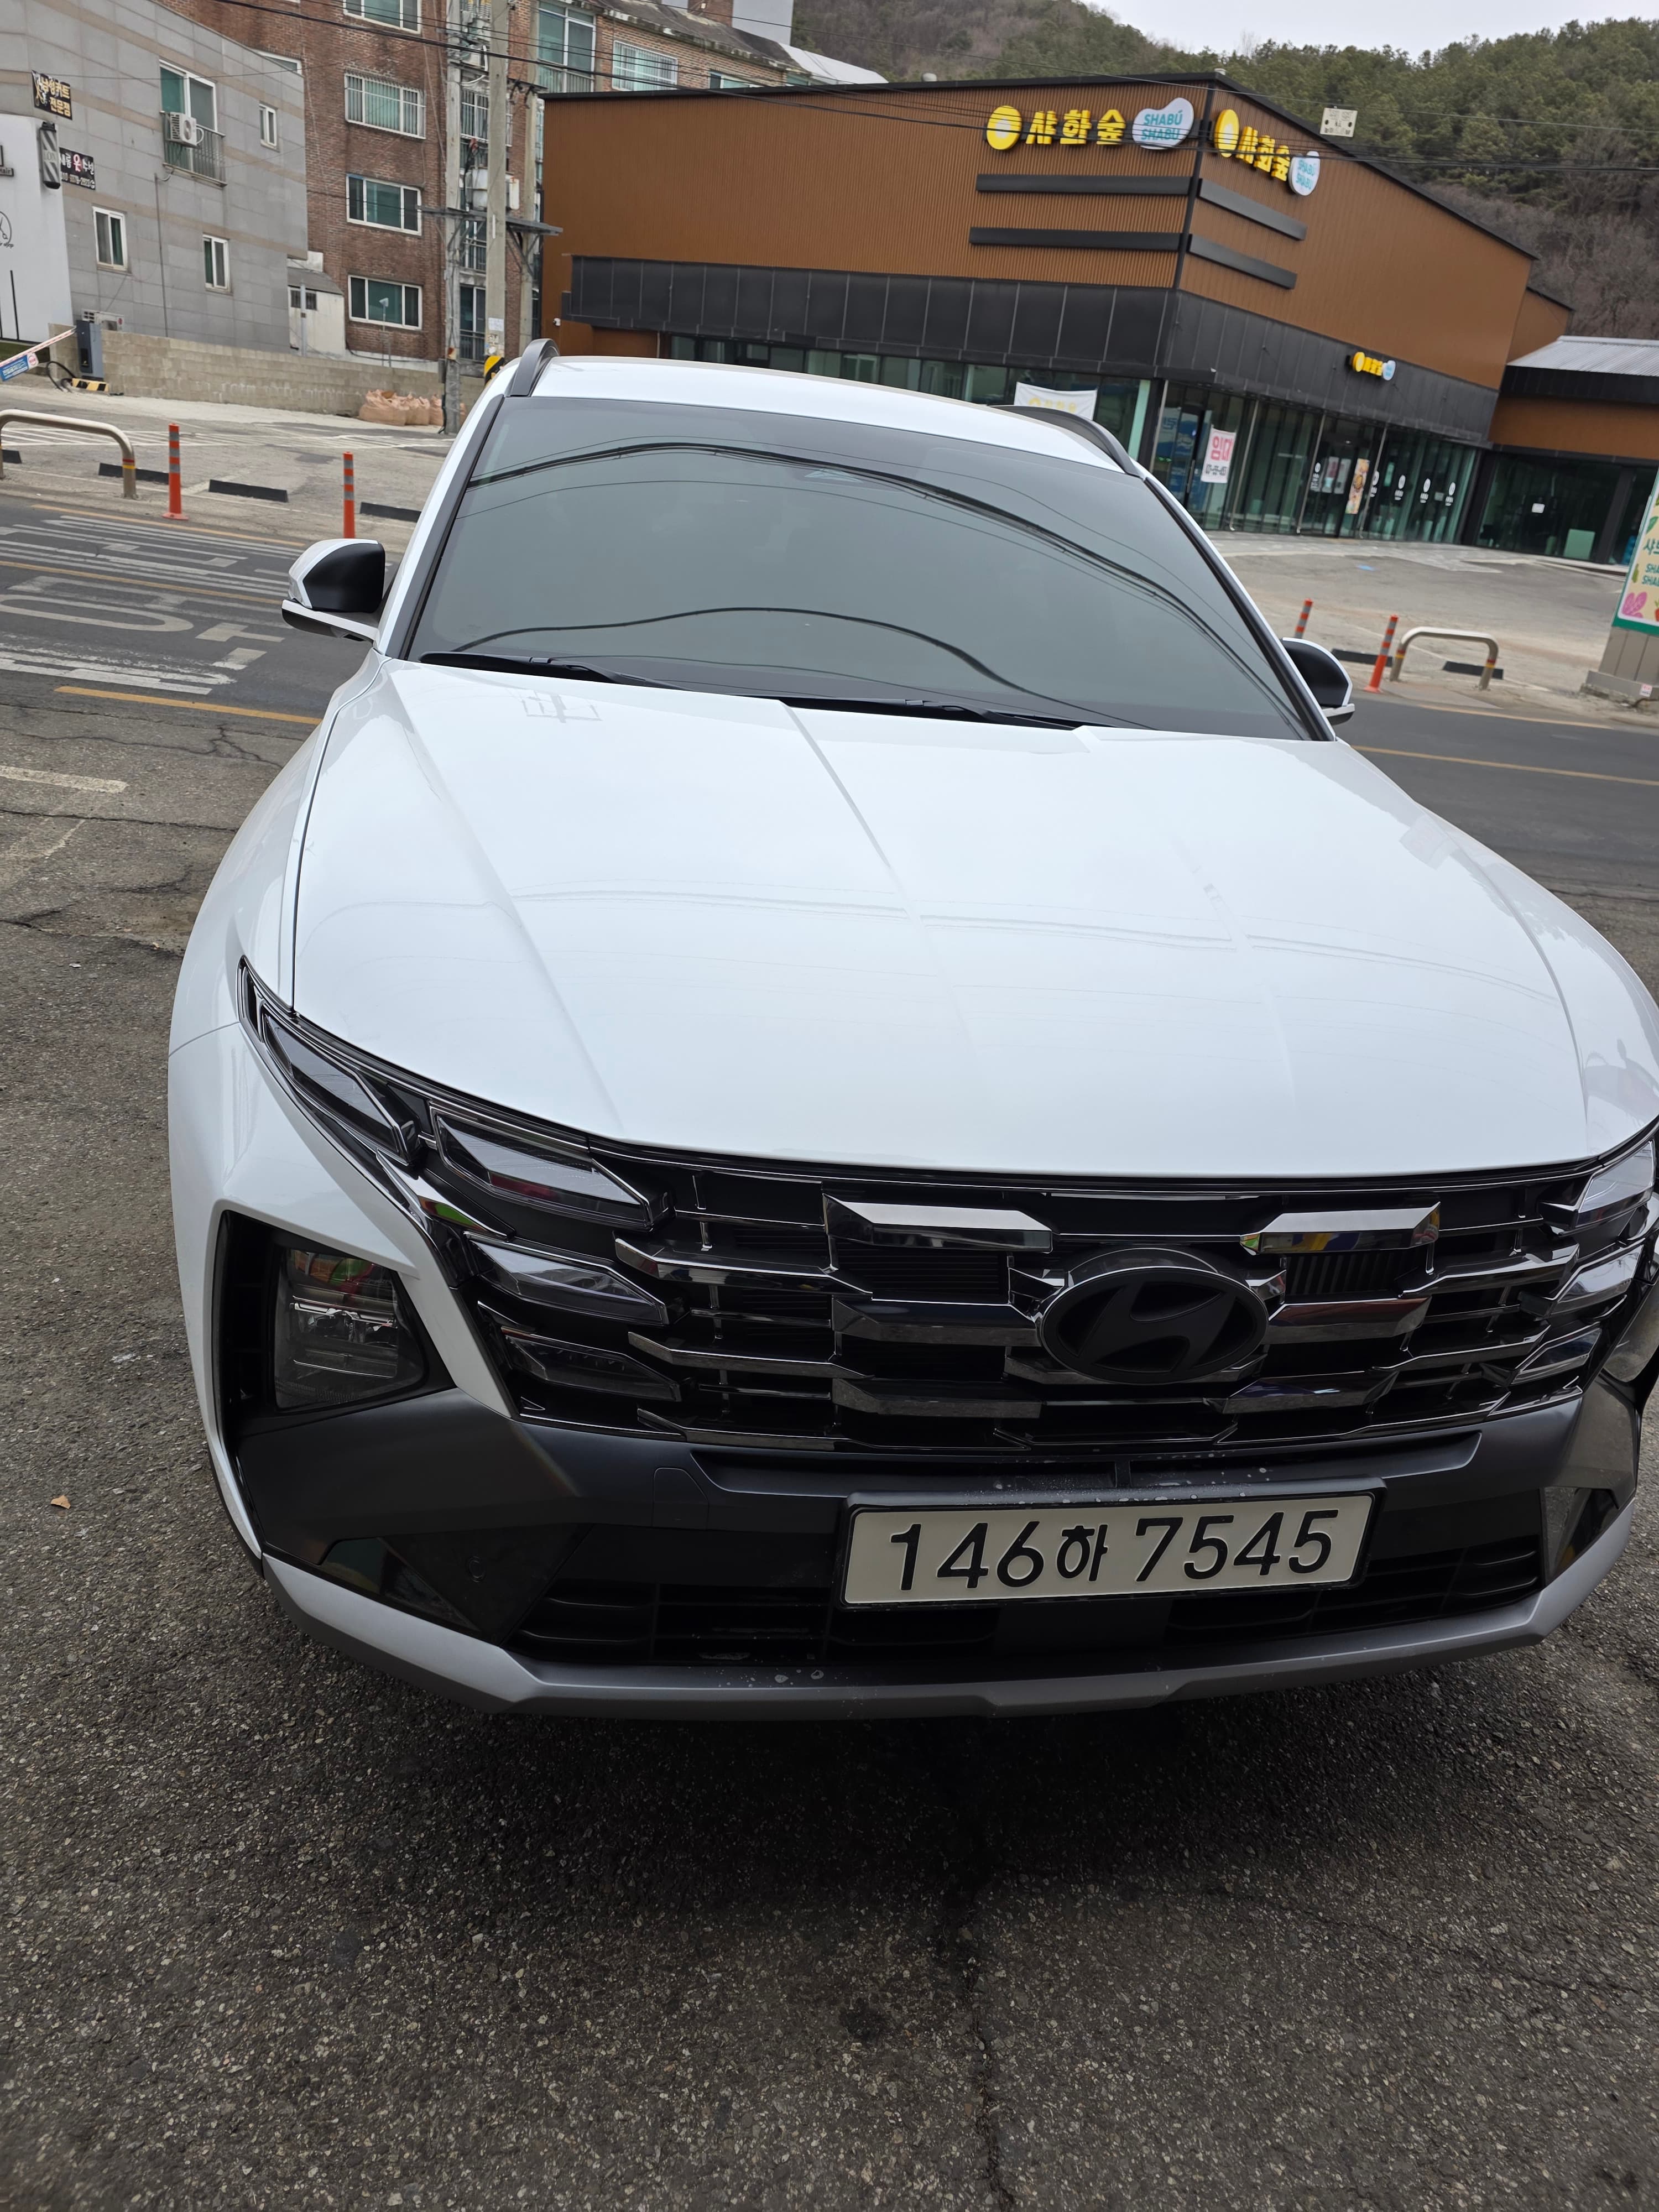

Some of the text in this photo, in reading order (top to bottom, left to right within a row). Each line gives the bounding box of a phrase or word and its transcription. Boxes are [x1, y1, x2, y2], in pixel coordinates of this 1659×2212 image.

[50, 97, 71, 117] 전문점
[1211, 436, 1233, 461] 임대
[891, 1510, 1338, 1590] 146하 7545
